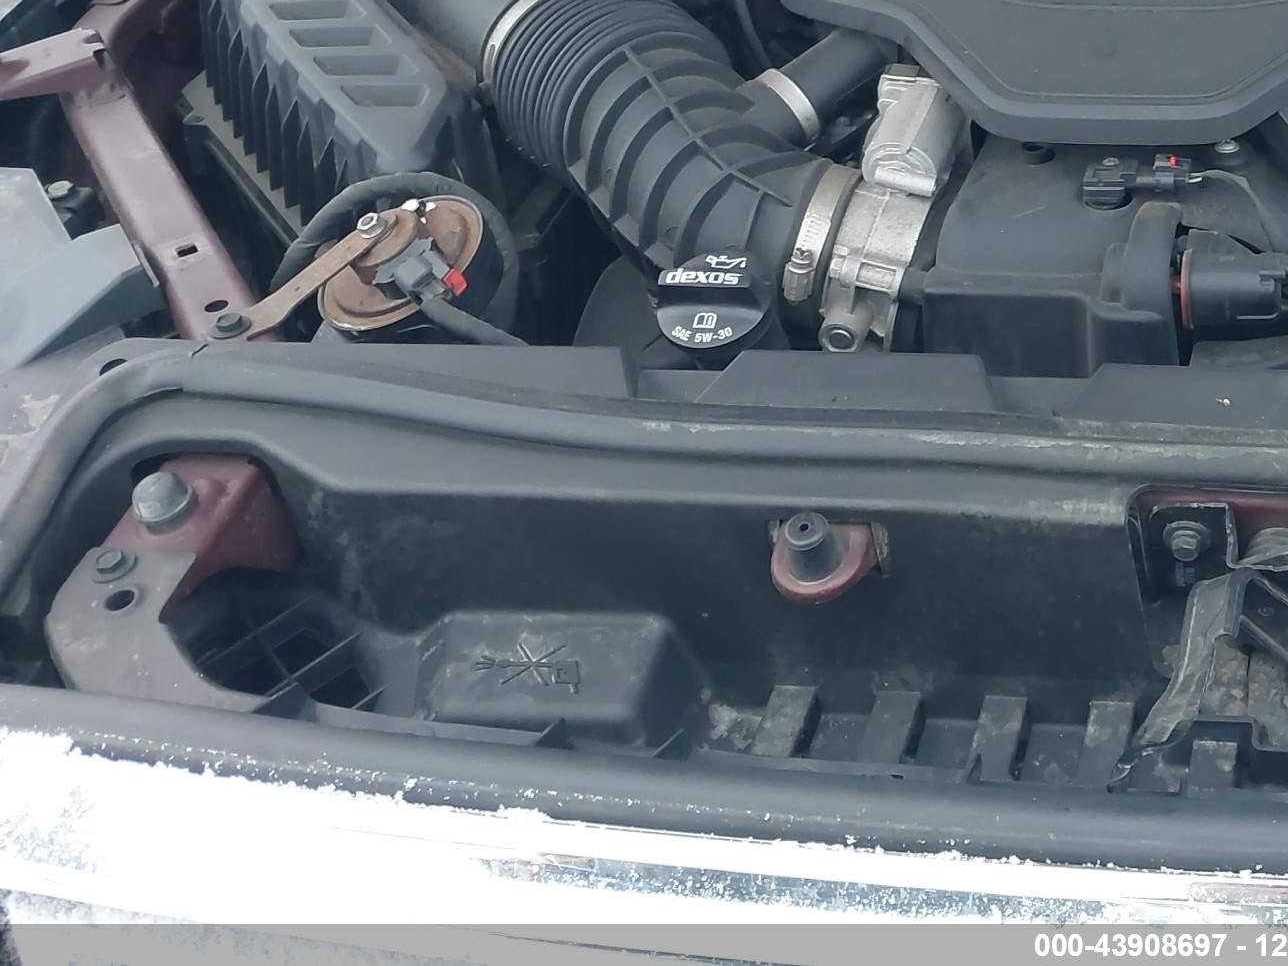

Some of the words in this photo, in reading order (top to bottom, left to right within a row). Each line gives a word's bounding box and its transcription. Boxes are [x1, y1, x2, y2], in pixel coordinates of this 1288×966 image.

[666, 268, 742, 285] dexos
[671, 325, 692, 341] SAE
[694, 326, 732, 343] 5W-30
